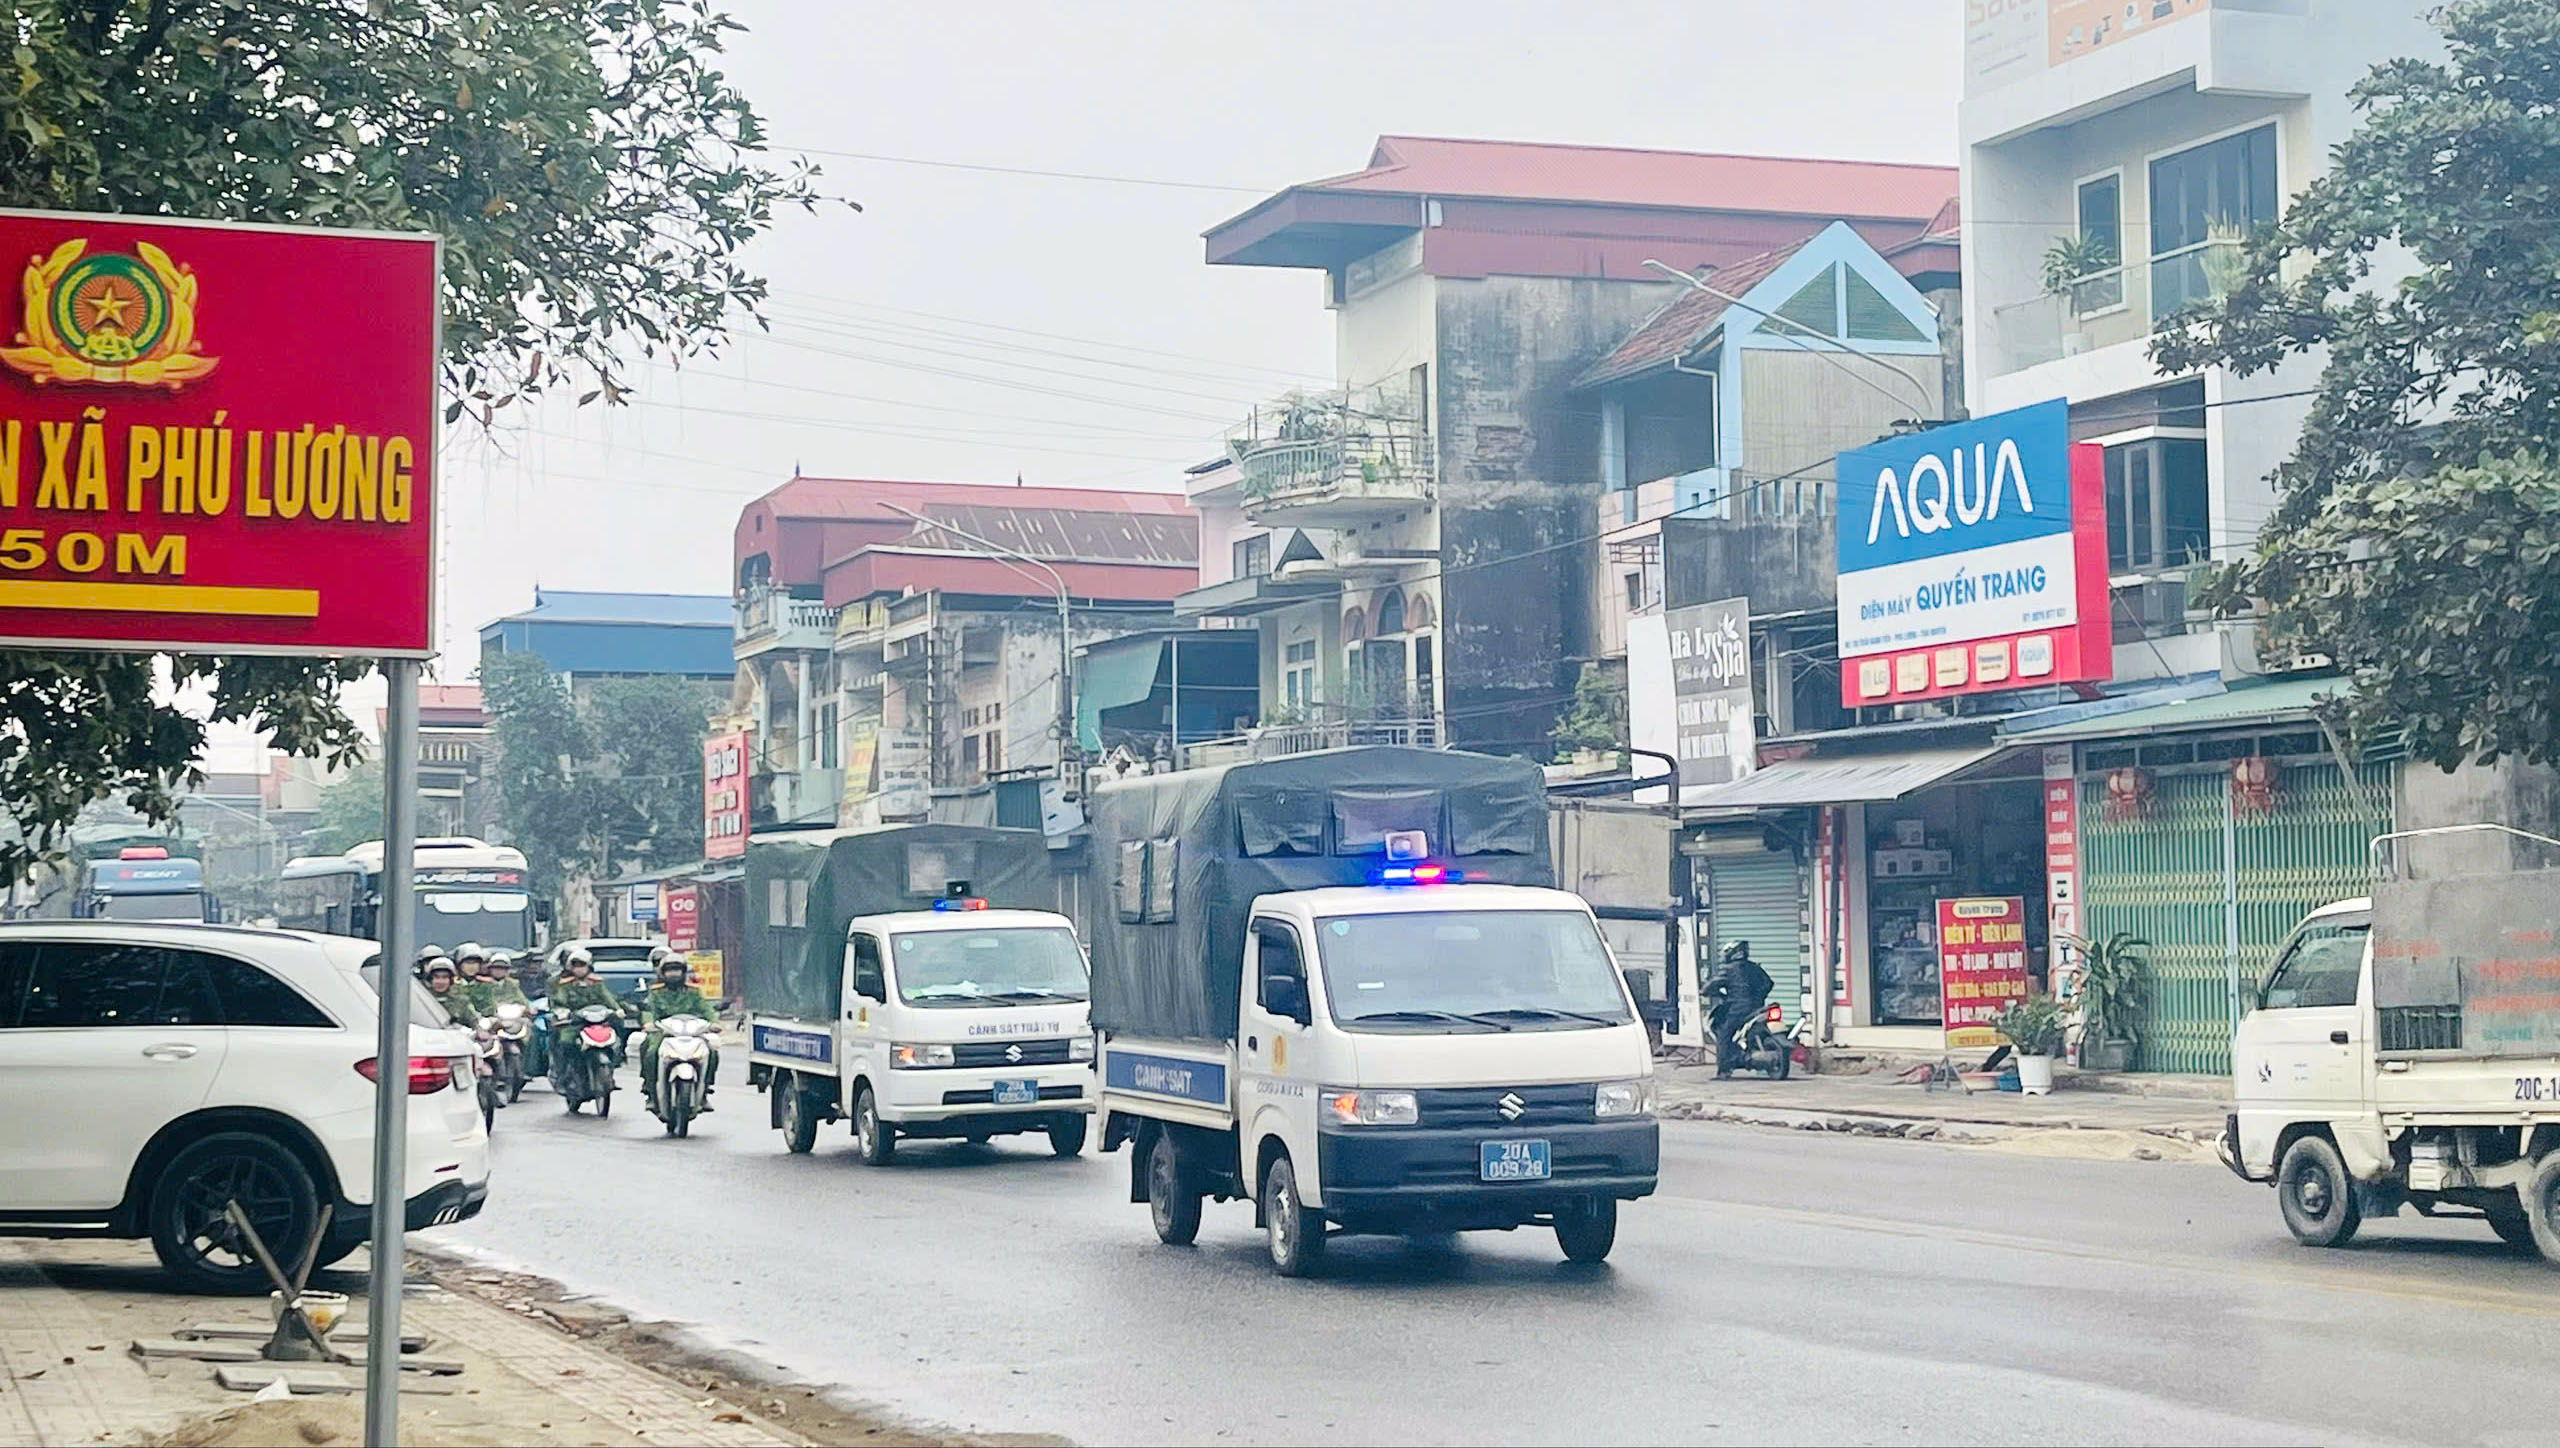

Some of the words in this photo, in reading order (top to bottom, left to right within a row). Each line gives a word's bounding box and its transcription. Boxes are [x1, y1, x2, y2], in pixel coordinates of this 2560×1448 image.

[36, 405, 109, 511] XÃ
[127, 410, 233, 516] PHÚ
[245, 422, 414, 524] LƯƠNG
[1867, 438, 2034, 545] AQUA
[1917, 567, 1976, 611] QUYẾN
[1982, 566, 2046, 600] TRANG
[1712, 632, 1745, 687] Spa
[2515, 1077, 2560, 1100] 20C-1
[1501, 1143, 1531, 1160] 20A
